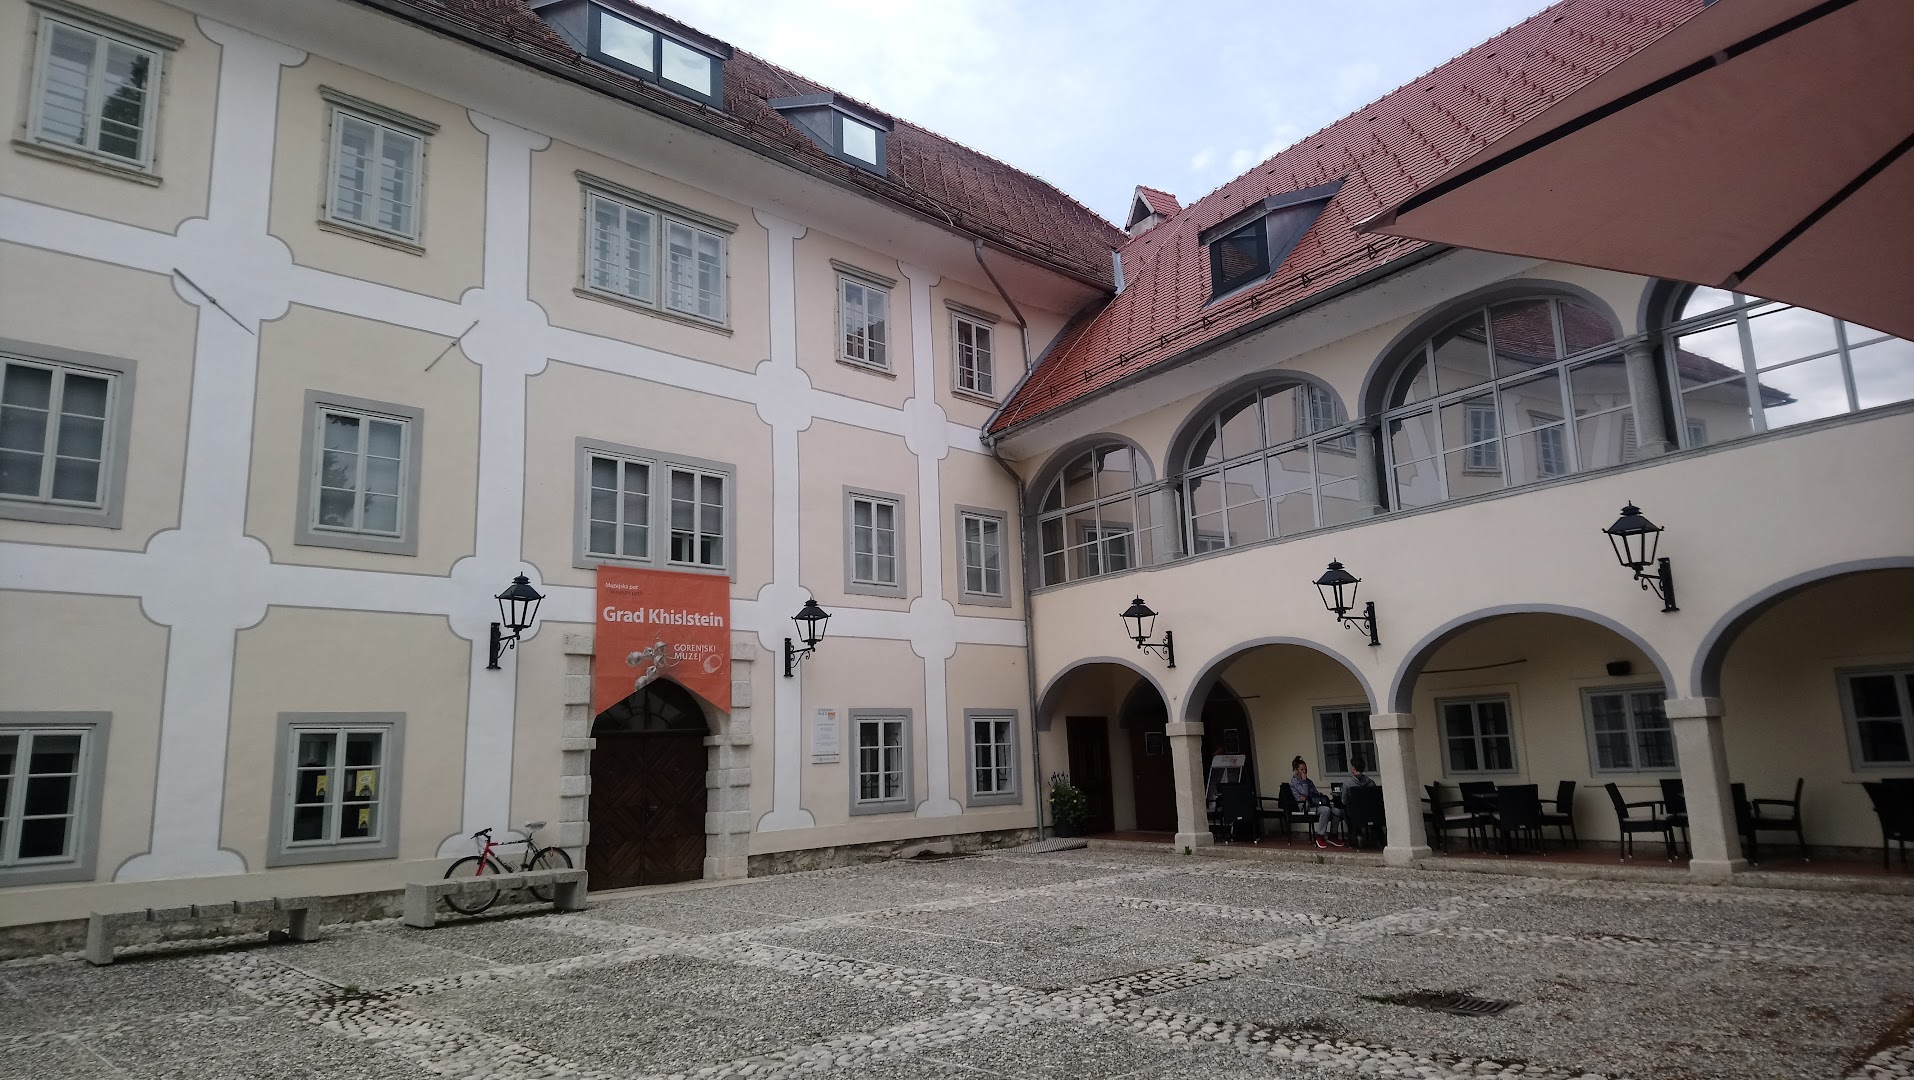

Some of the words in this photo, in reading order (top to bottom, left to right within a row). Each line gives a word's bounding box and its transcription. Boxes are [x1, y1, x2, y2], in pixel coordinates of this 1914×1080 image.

[603, 606, 644, 623] Grad
[649, 609, 723, 627] Khislstein
[674, 644, 716, 653] GORENJSKI
[674, 653, 702, 662] MUZEJ
